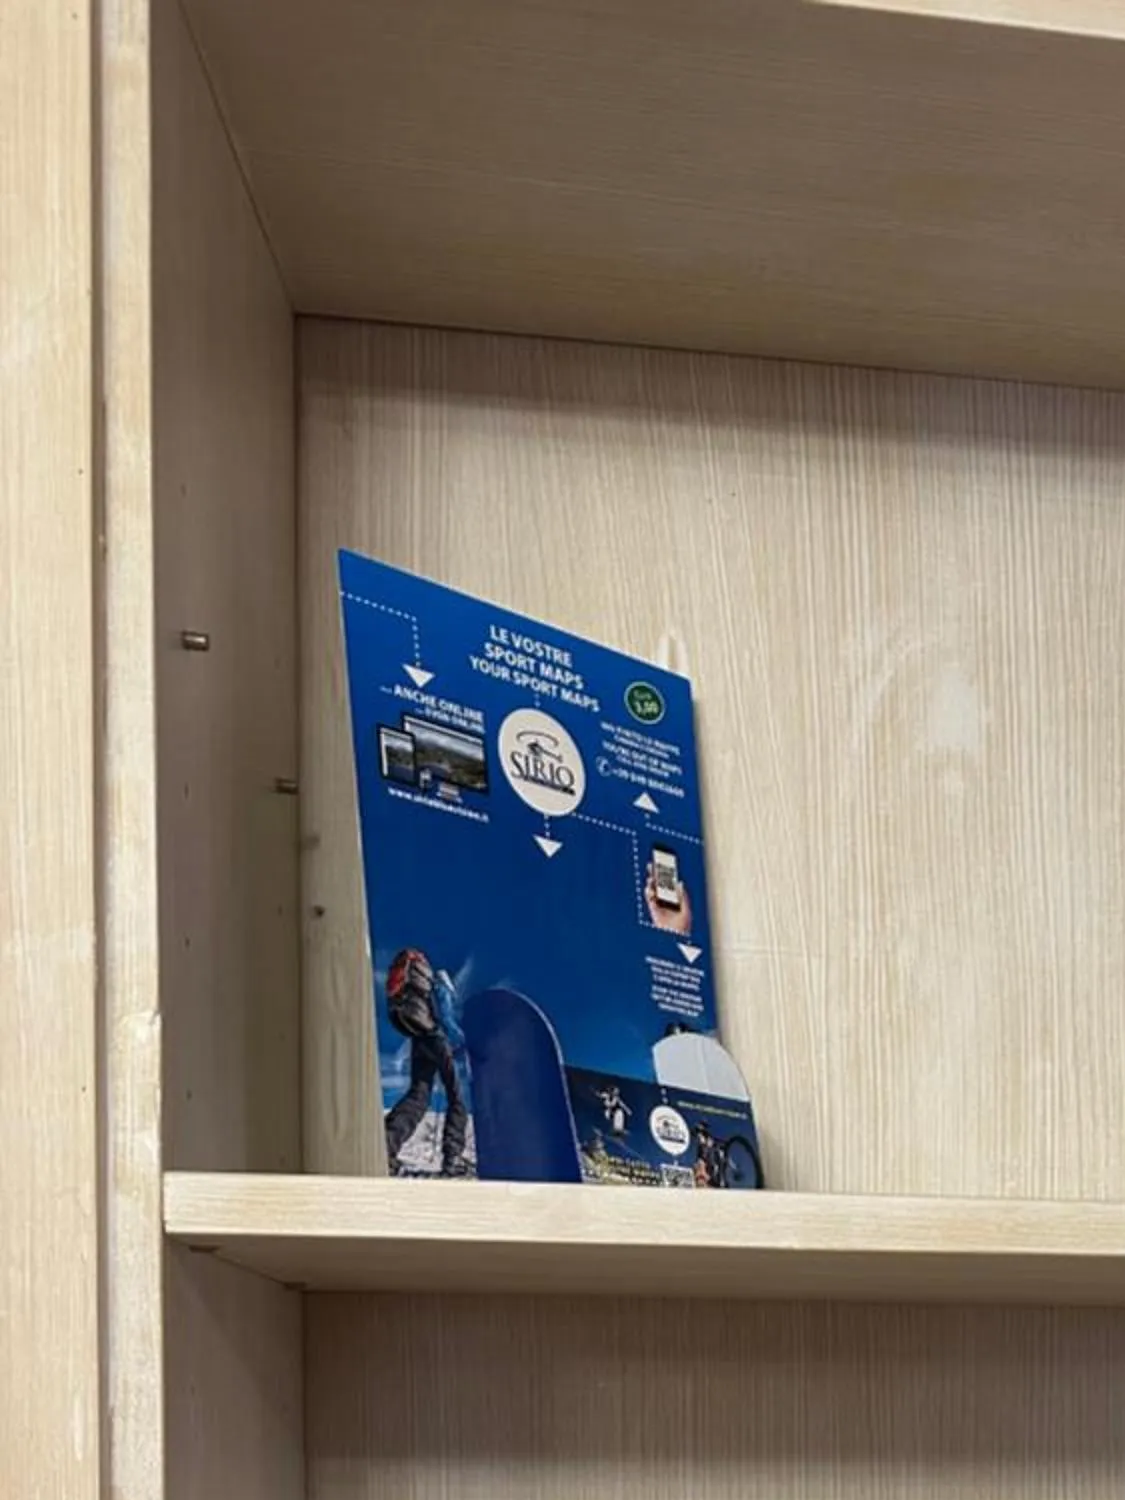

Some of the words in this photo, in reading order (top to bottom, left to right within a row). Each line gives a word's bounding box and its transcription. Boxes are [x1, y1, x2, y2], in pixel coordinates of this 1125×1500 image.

[484, 642, 536, 673] SPORT
[540, 662, 584, 690] MAPS
[489, 624, 509, 646] LE
[510, 632, 573, 669] VOSTRE
[469, 654, 511, 682] YOUR
[512, 670, 558, 698] SPORT
[560, 687, 600, 713] MAPS
[510, 750, 575, 788] SIRIO
